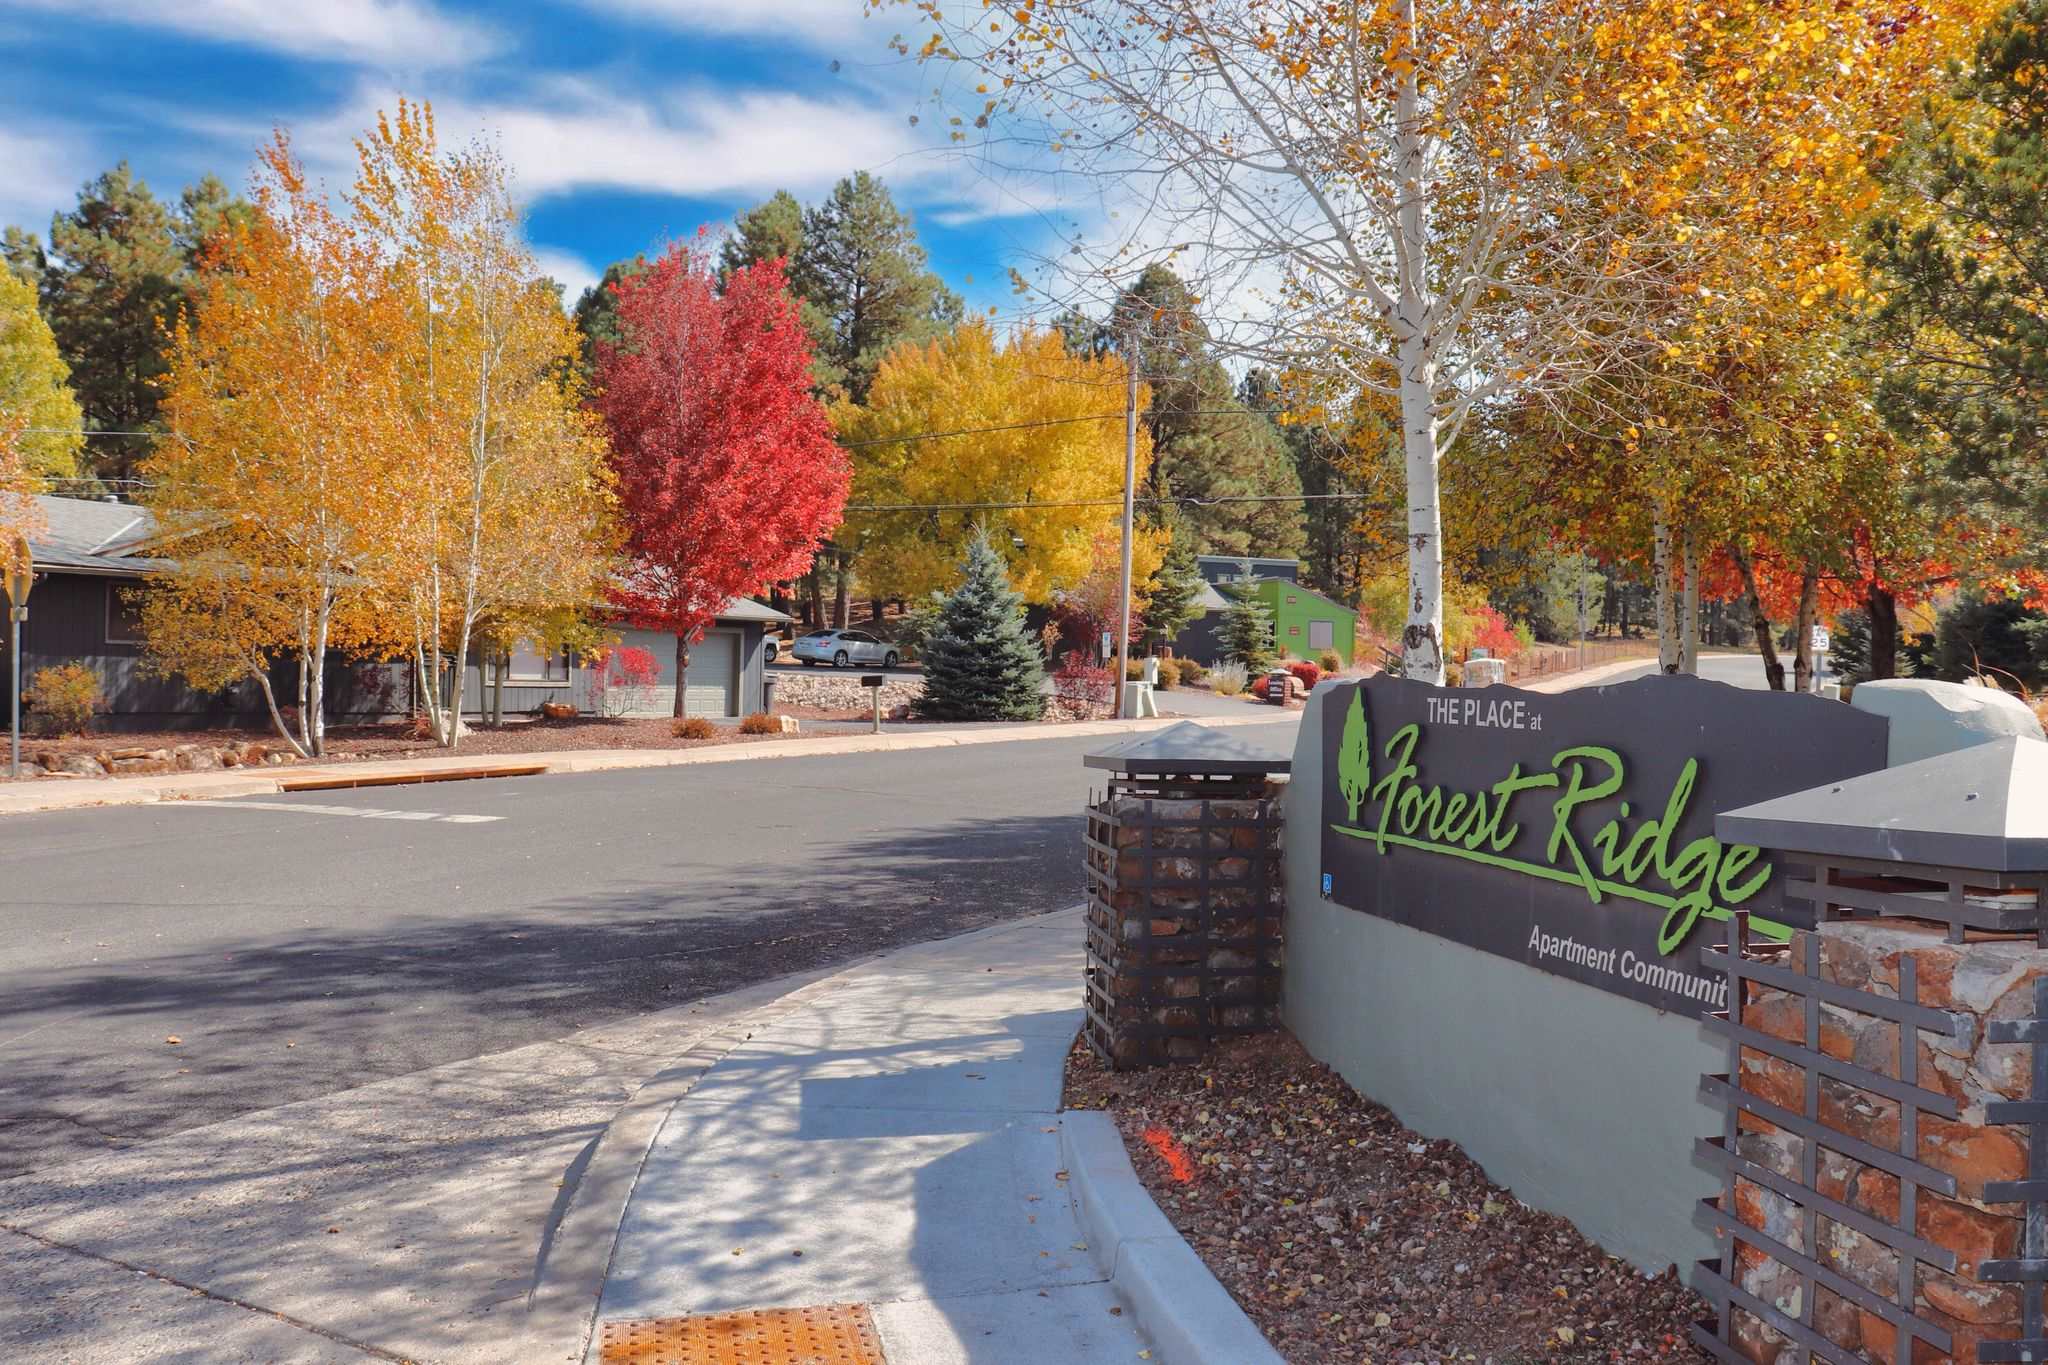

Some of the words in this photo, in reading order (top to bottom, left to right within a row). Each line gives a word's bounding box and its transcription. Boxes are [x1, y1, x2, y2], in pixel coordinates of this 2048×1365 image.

[1811, 638, 1828, 648] 25
[1427, 697, 1460, 724] THE
[1464, 699, 1526, 729] PLACE
[1530, 713, 1542, 730] at
[1373, 724, 1559, 855] Forest
[1547, 746, 1772, 956] Ridge
[1528, 924, 1616, 975] Apartment
[1620, 950, 1729, 1008] Communit
